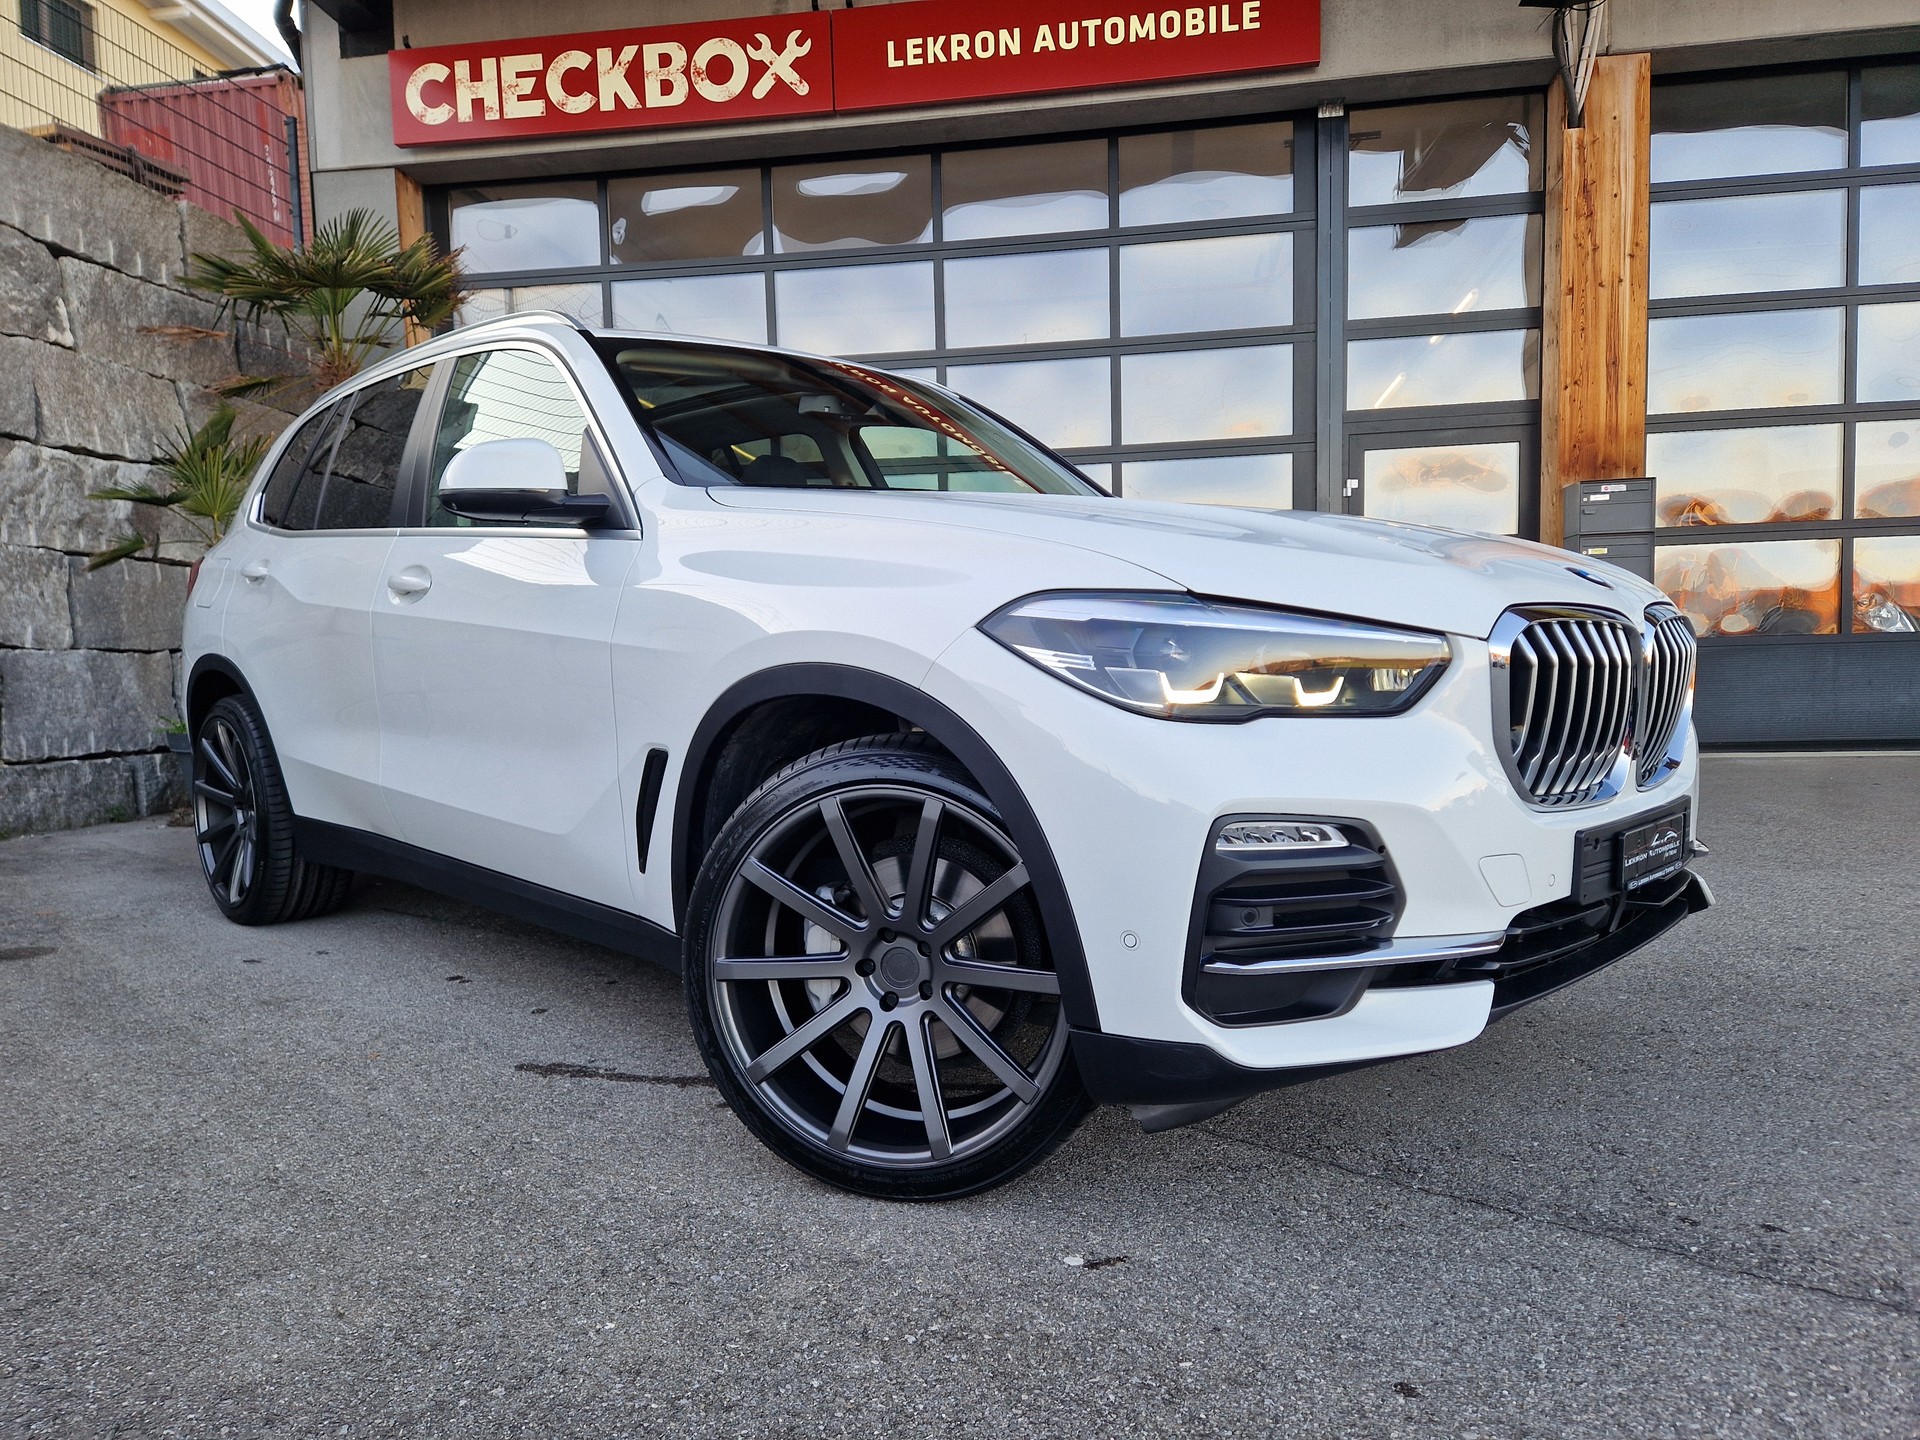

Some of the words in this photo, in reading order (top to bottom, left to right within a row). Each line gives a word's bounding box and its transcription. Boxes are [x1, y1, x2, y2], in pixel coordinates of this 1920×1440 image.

[886, 27, 1021, 69] LEKRON
[1032, 0, 1262, 54] AUTOMOBILE
[404, 28, 812, 126] CHECKBOX
